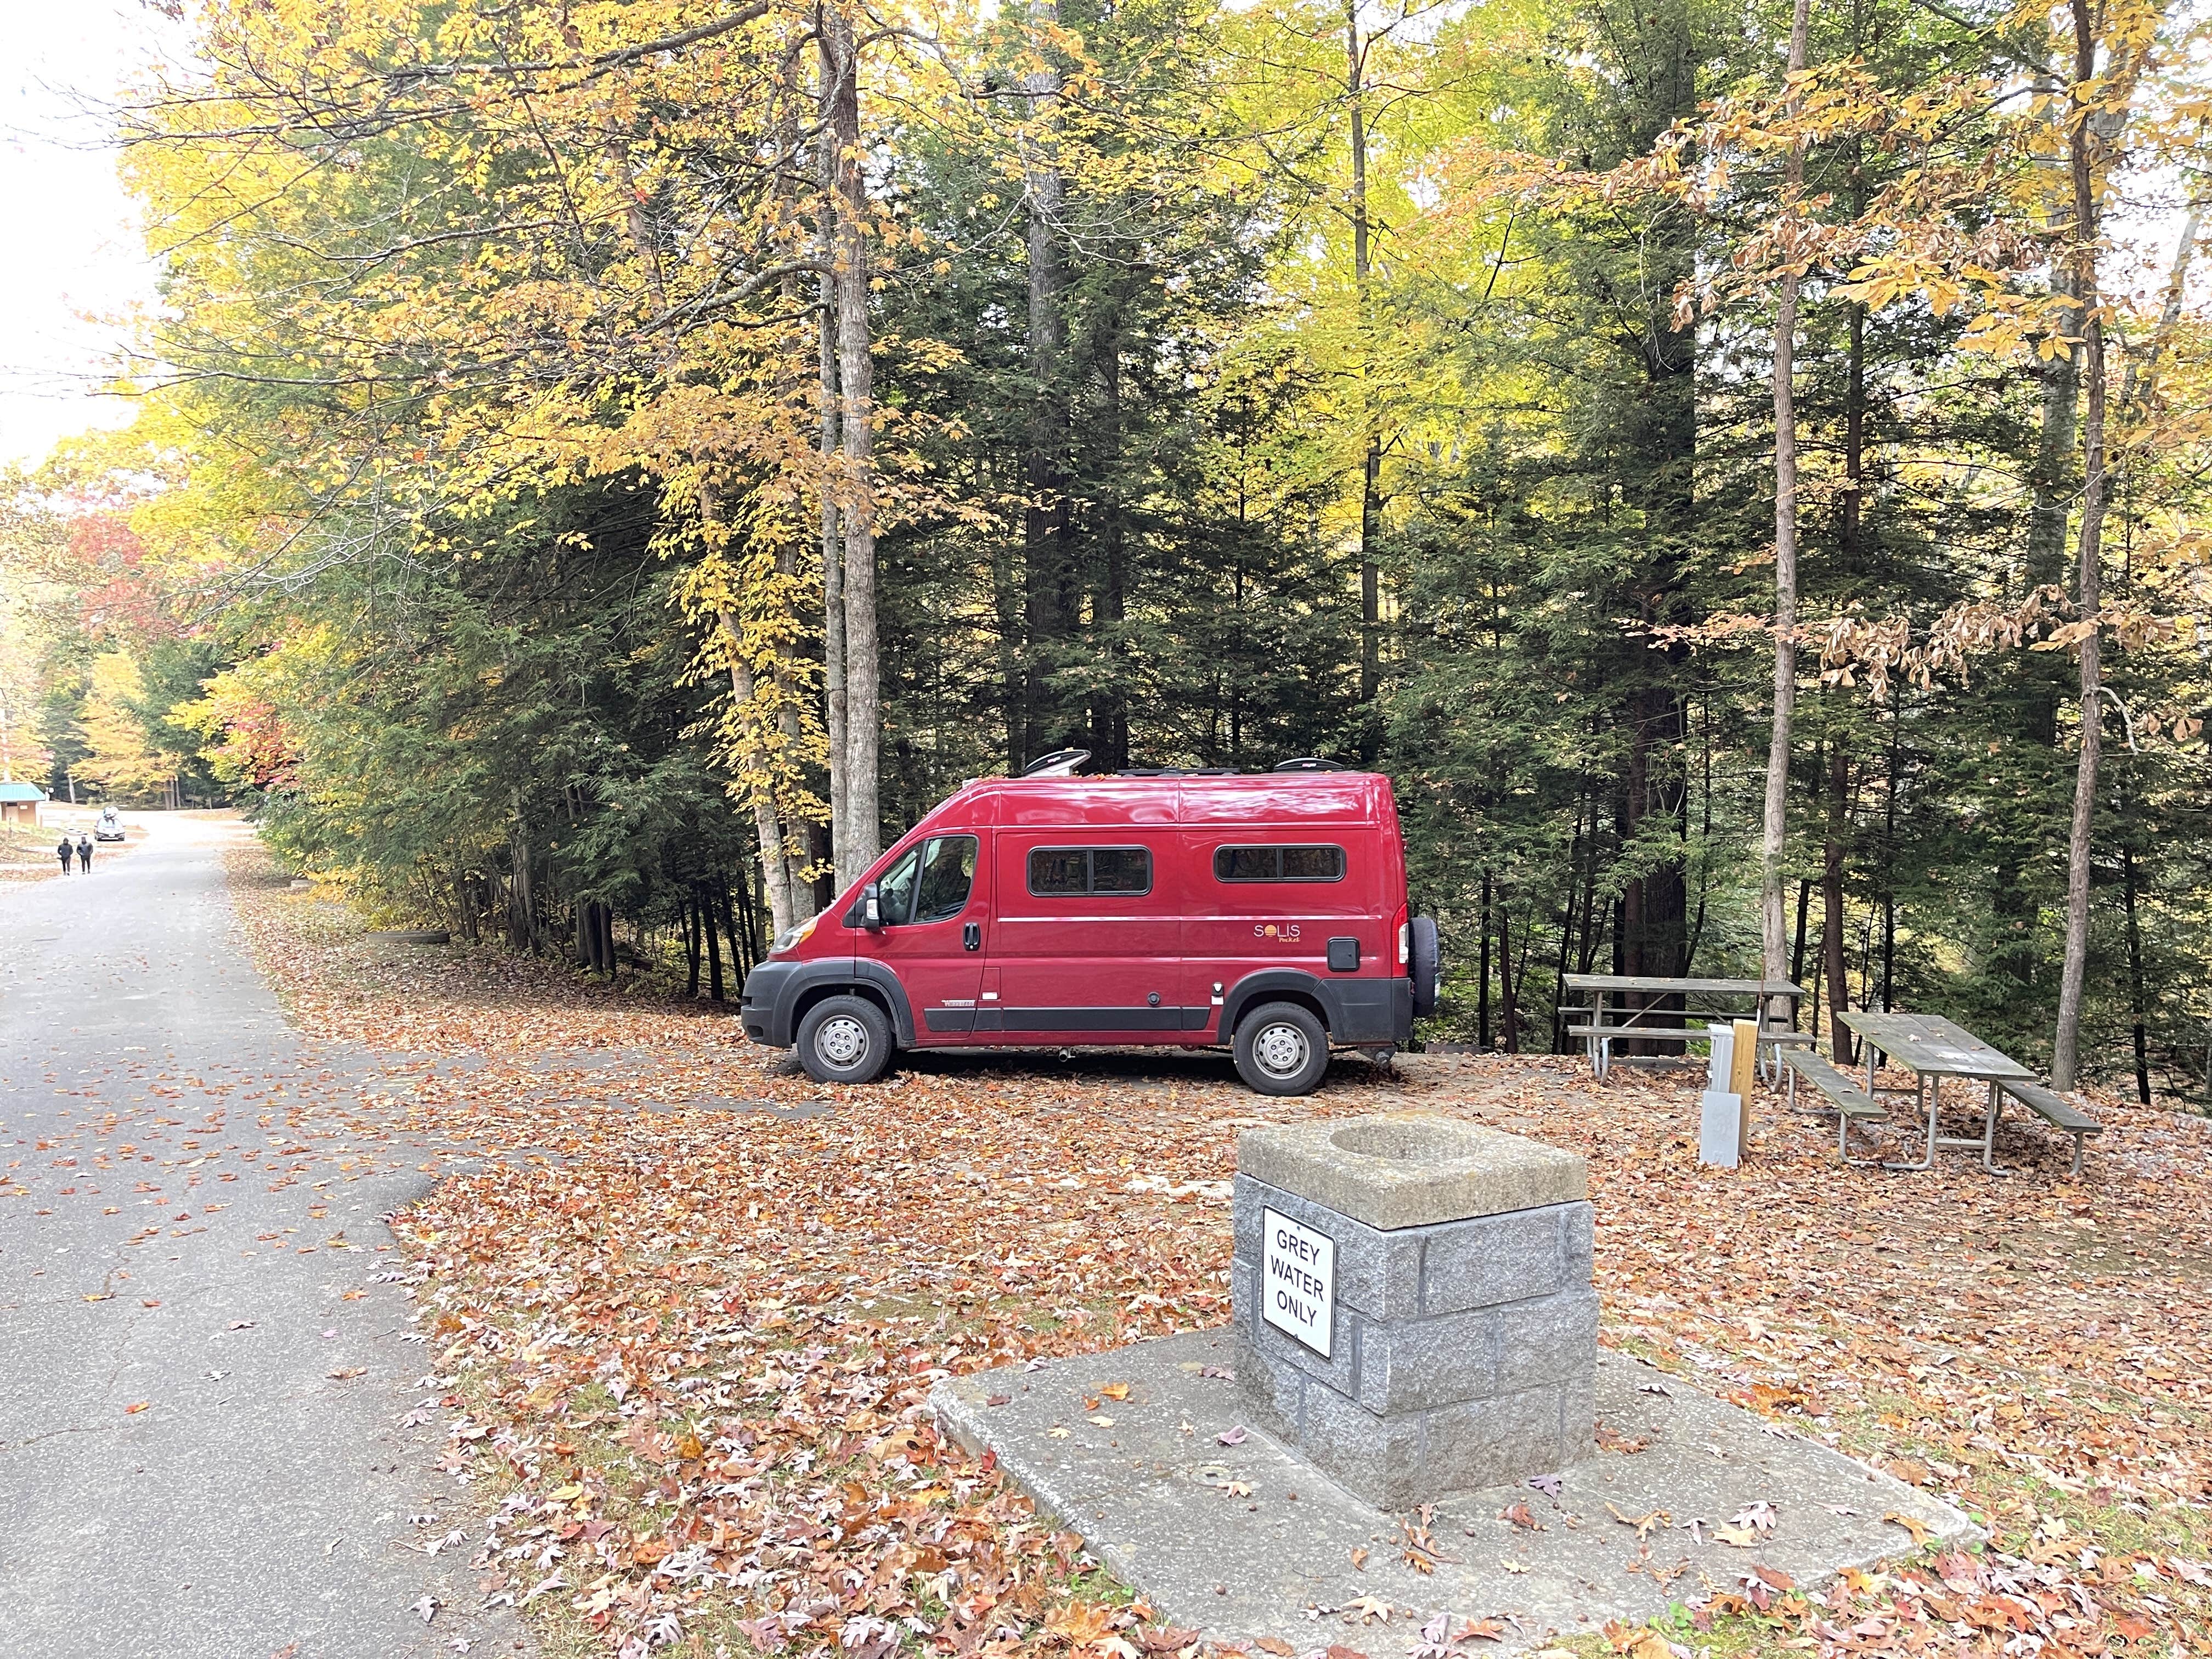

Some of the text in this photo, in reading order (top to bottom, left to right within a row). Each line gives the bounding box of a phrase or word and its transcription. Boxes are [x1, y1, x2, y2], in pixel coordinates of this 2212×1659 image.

[1277, 1229, 1319, 1265] GREY
[1271, 1255, 1324, 1301] WATER
[1277, 1290, 1317, 1327] ONLY
